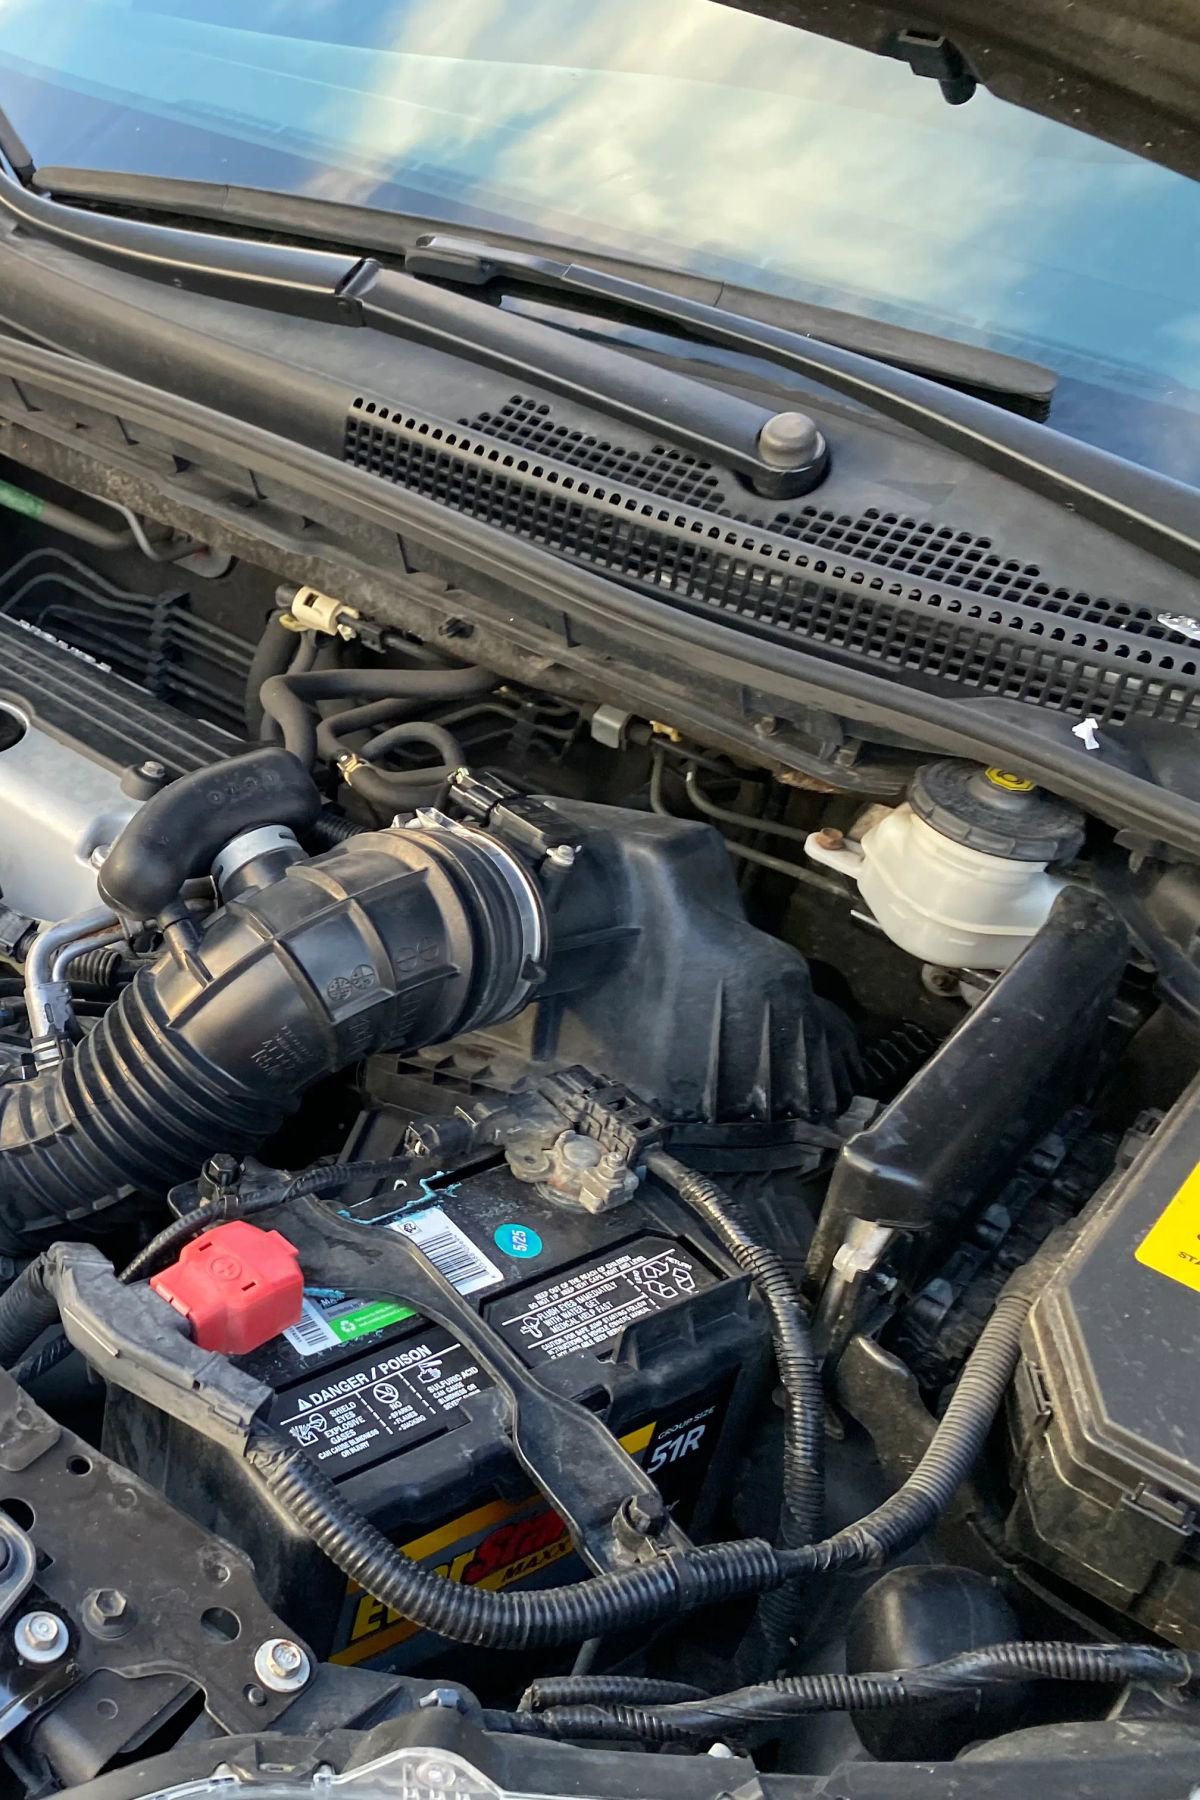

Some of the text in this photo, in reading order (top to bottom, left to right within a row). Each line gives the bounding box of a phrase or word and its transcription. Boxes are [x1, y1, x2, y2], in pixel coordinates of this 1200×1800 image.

[512, 1230, 527, 1252] 5/25
[534, 1291, 548, 1300] KEEP
[548, 1285, 561, 1294] OUT
[536, 1297, 550, 1306] NOT
[537, 1281, 618, 1321] FLUSH EYES IMMEDIATELY
[542, 1314, 563, 1327] WITH
[584, 1298, 600, 1308] GET
[550, 1301, 614, 1333] MEDICAL HELP FAST
[309, 1344, 432, 1406] DANGER / POISON
[426, 1366, 479, 1393] SULFURIC ACID
[432, 1381, 465, 1399] CAN CAUSE
[329, 1401, 357, 1417] SHIELD
[389, 1401, 402, 1410] NO
[323, 1415, 366, 1438] EXPLOSIVE
[335, 1410, 356, 1424] EYES
[658, 1405, 716, 1439] GROUP SIZE
[318, 1428, 380, 1460] CAN CAUSE BLINDNESS
[330, 1429, 357, 1444] GASES
[340, 1440, 370, 1458] OR INJURY
[647, 1425, 706, 1474] 51R
